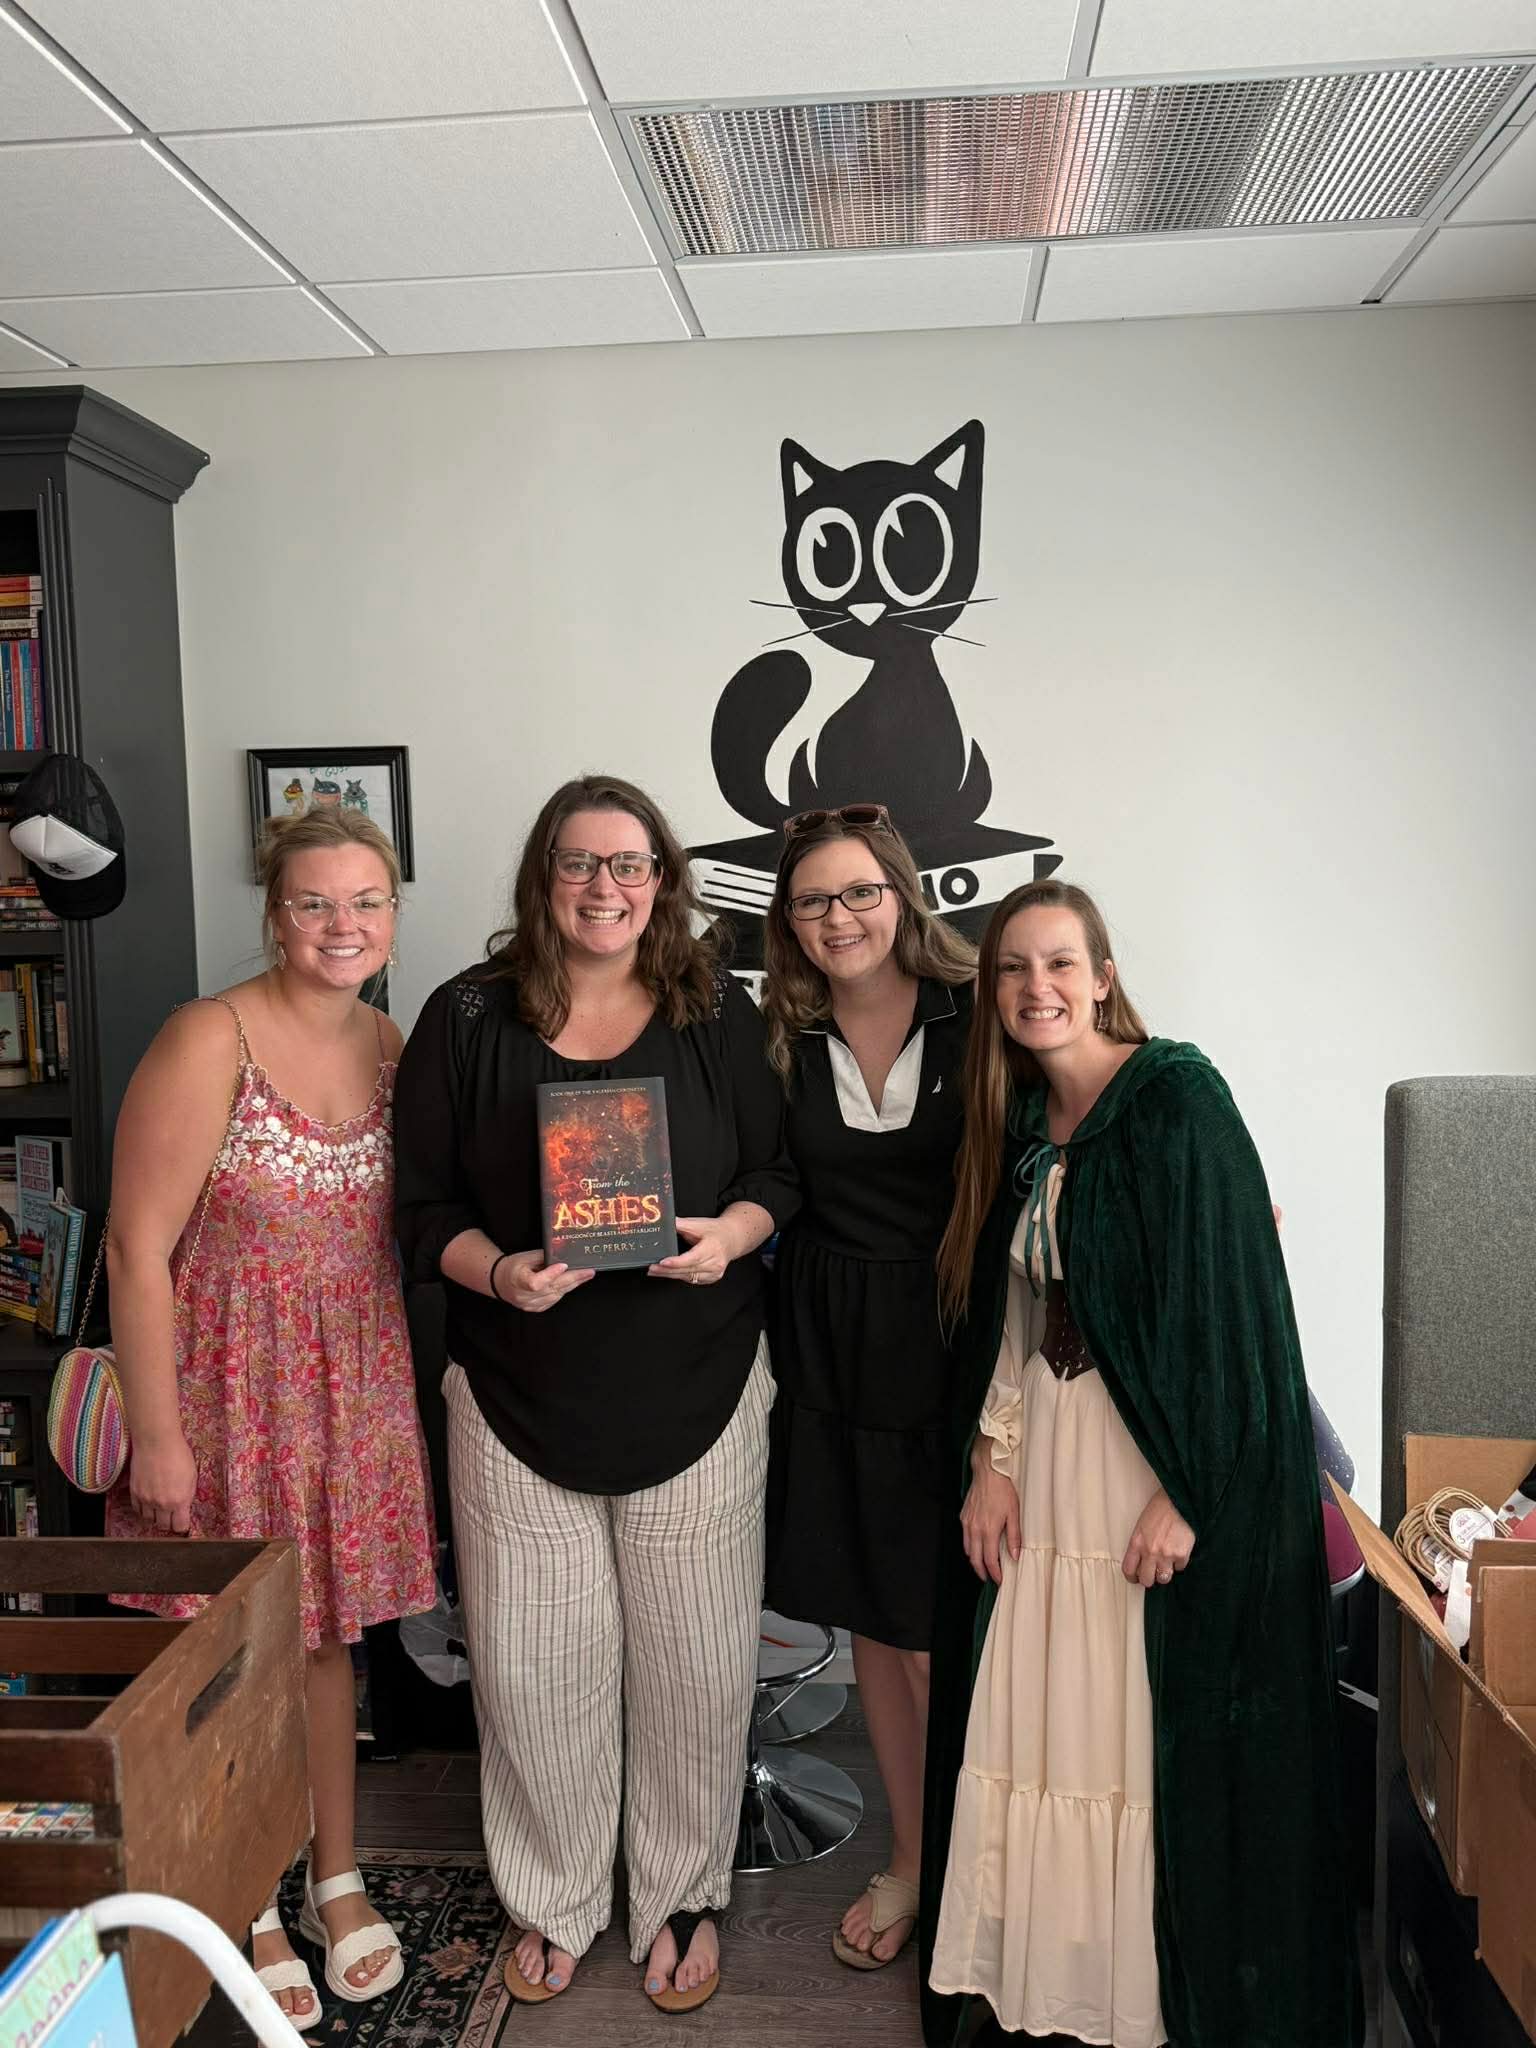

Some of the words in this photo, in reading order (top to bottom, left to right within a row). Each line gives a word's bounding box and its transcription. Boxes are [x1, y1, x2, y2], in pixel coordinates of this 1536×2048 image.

[579, 1178, 612, 1196] From
[614, 1174, 630, 1187] the
[552, 1194, 661, 1230] ASHES
[603, 1242, 636, 1253] PERRY
